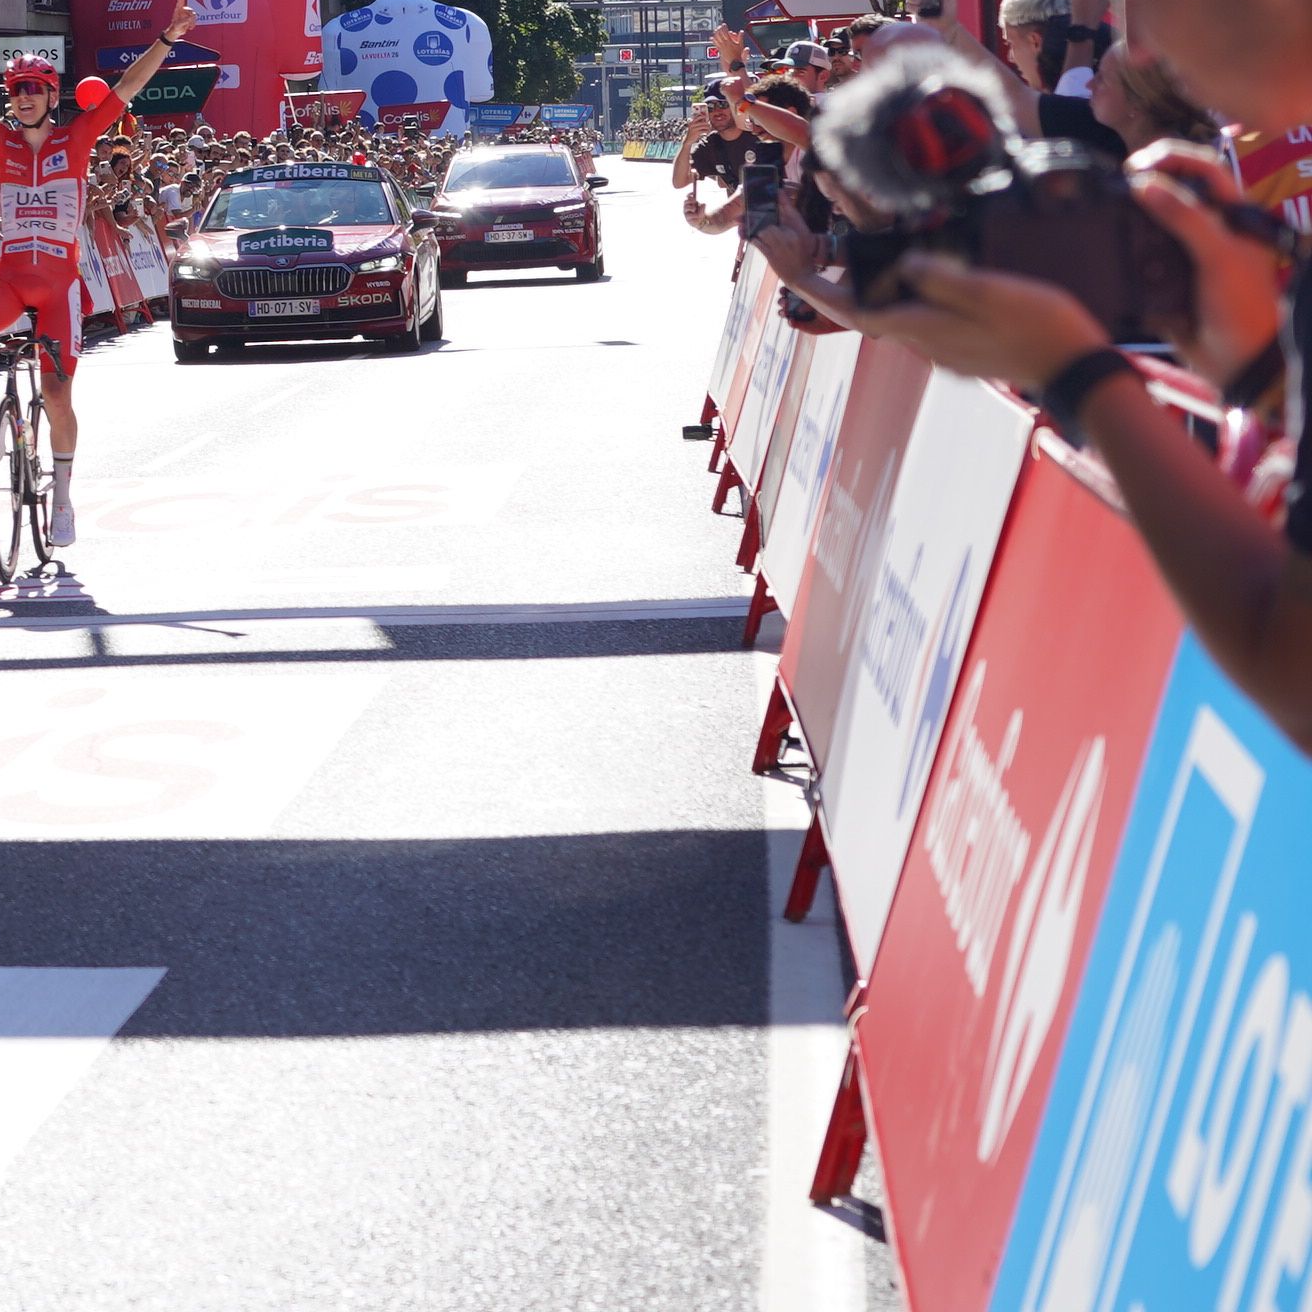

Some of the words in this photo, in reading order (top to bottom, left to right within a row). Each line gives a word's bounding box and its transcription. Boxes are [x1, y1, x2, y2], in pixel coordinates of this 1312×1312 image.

[108, 0, 153, 12] Santini
[116, 20, 142, 30] VUELTA
[360, 39, 399, 49] Santini
[417, 48, 450, 56] LOTERÍAS
[253, 165, 348, 181] Fertiberia
[353, 170, 373, 179] META
[17, 190, 57, 205] UAE
[17, 220, 57, 230] XRG
[240, 234, 328, 251] Fertiberia
